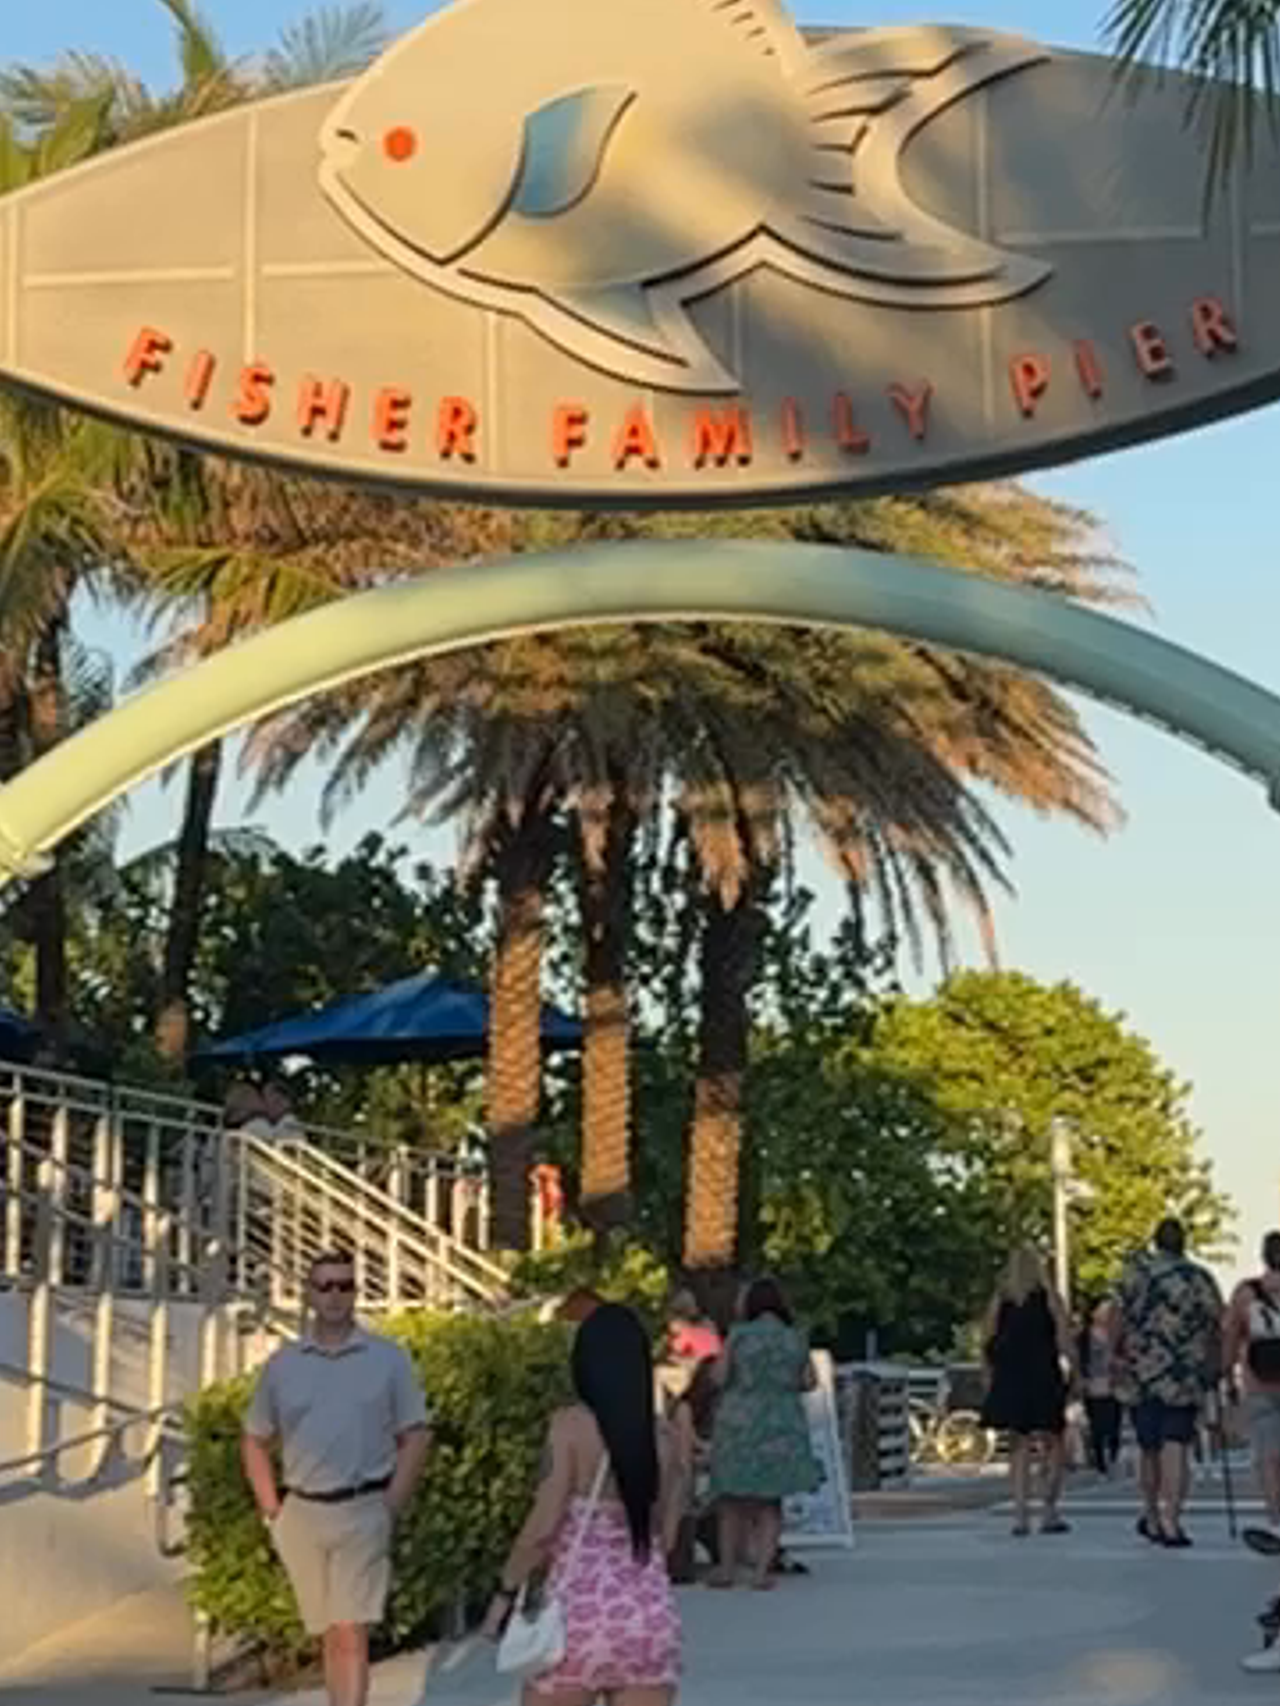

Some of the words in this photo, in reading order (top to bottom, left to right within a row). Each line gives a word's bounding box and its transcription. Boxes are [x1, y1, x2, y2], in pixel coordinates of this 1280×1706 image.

[124, 327, 477, 463] FISHER
[552, 381, 932, 470] FAMILY
[1009, 296, 1239, 415] PIER
